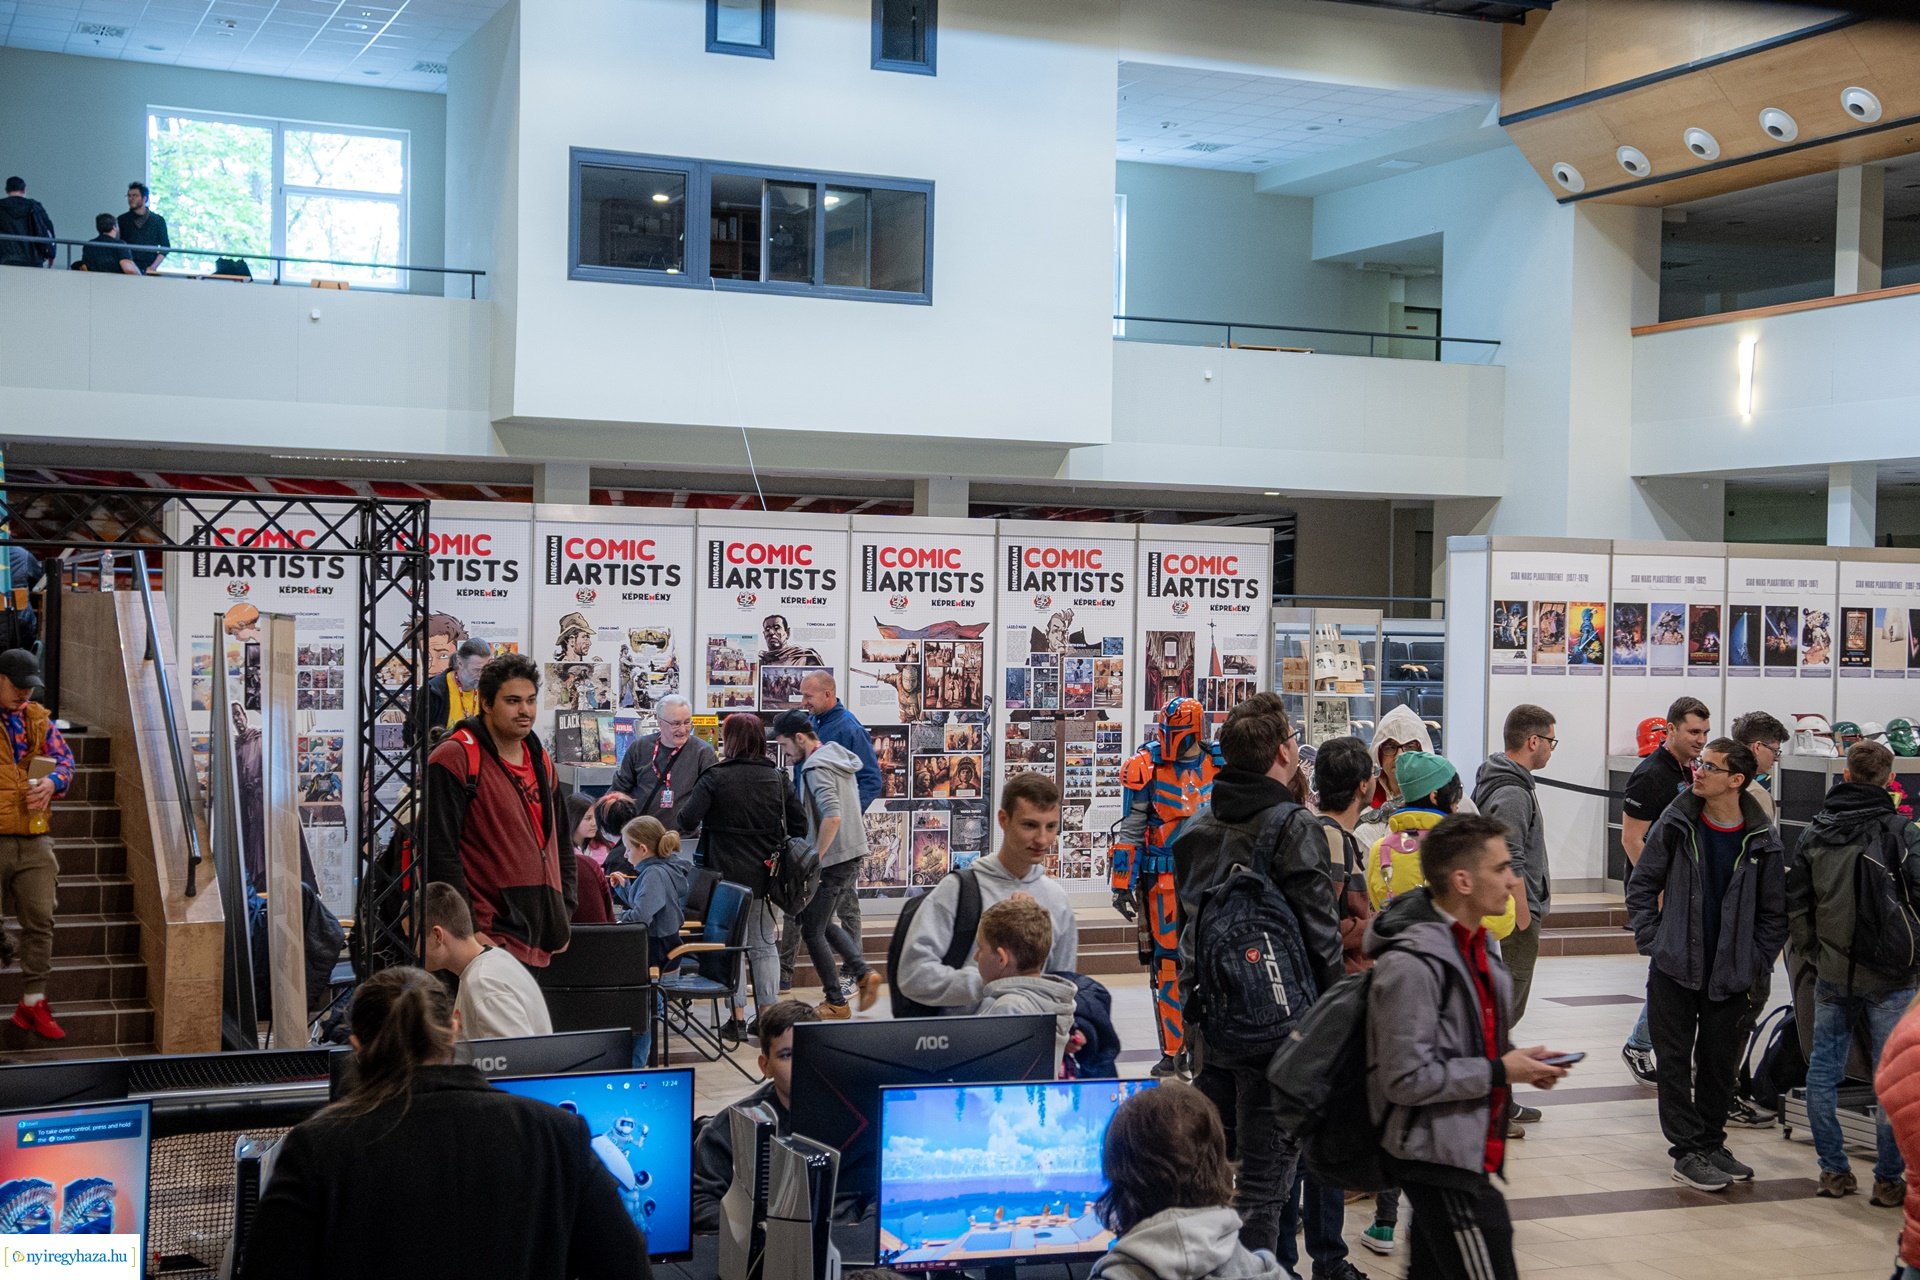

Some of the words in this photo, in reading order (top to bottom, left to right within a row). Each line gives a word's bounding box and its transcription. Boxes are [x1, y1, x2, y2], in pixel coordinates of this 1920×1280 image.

[214, 528, 316, 549] COMIC
[565, 537, 656, 561] COMIC
[550, 537, 558, 583] HUNGARIAN
[727, 543, 812, 566] COMIC
[880, 547, 961, 569] COMIC
[1024, 547, 1102, 569] COMIC
[1163, 554, 1238, 576] COMIC
[214, 554, 345, 579] ARTISTS
[564, 563, 681, 587] ARTISTS
[1511, 572, 1520, 580] STAR
[1521, 572, 1532, 580] WARS
[726, 567, 836, 591] ARTISTS
[879, 571, 984, 593] ARTISTS
[1023, 571, 1124, 593] ARTISTS
[1162, 577, 1259, 599] ARTISTS
[1631, 575, 1640, 583] STAR
[1641, 575, 1651, 583] WARS
[1746, 578, 1754, 586] STAR
[1756, 578, 1766, 586] WARS
[1856, 580, 1864, 588] STAR
[1865, 580, 1874, 588] WARS
[559, 715, 579, 730] BLACK
[915, 1036, 949, 1050] AOC
